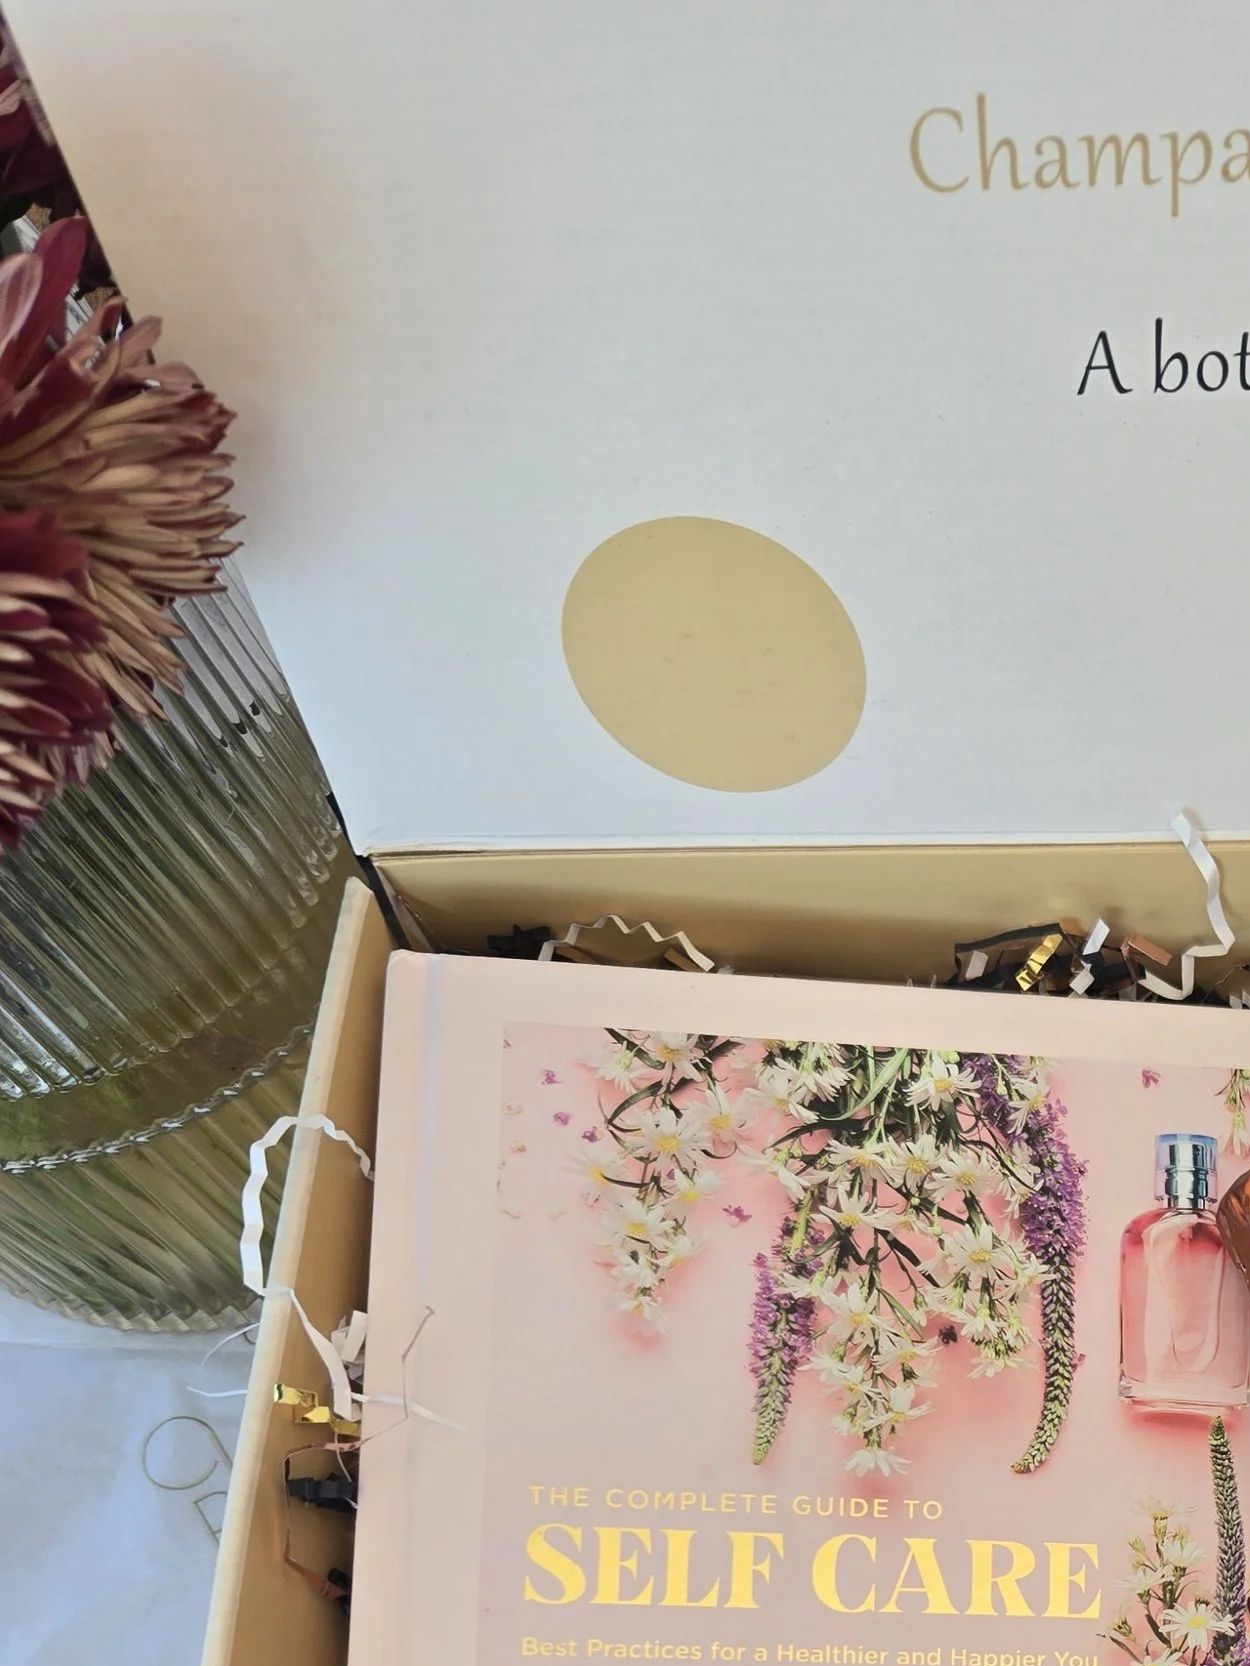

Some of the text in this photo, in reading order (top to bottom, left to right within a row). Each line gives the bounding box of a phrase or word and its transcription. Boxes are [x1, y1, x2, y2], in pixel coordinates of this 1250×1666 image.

[1075, 329, 1133, 396] A
[528, 1485, 943, 1520] THE COMPLETE GUIDE TO
[522, 1523, 1103, 1620] SELF CARE
[520, 1636, 579, 1658] Best
[586, 1638, 702, 1662] Practices
[710, 1640, 745, 1662] for
[754, 1647, 769, 1662] a
[776, 1643, 889, 1666] Healthier
